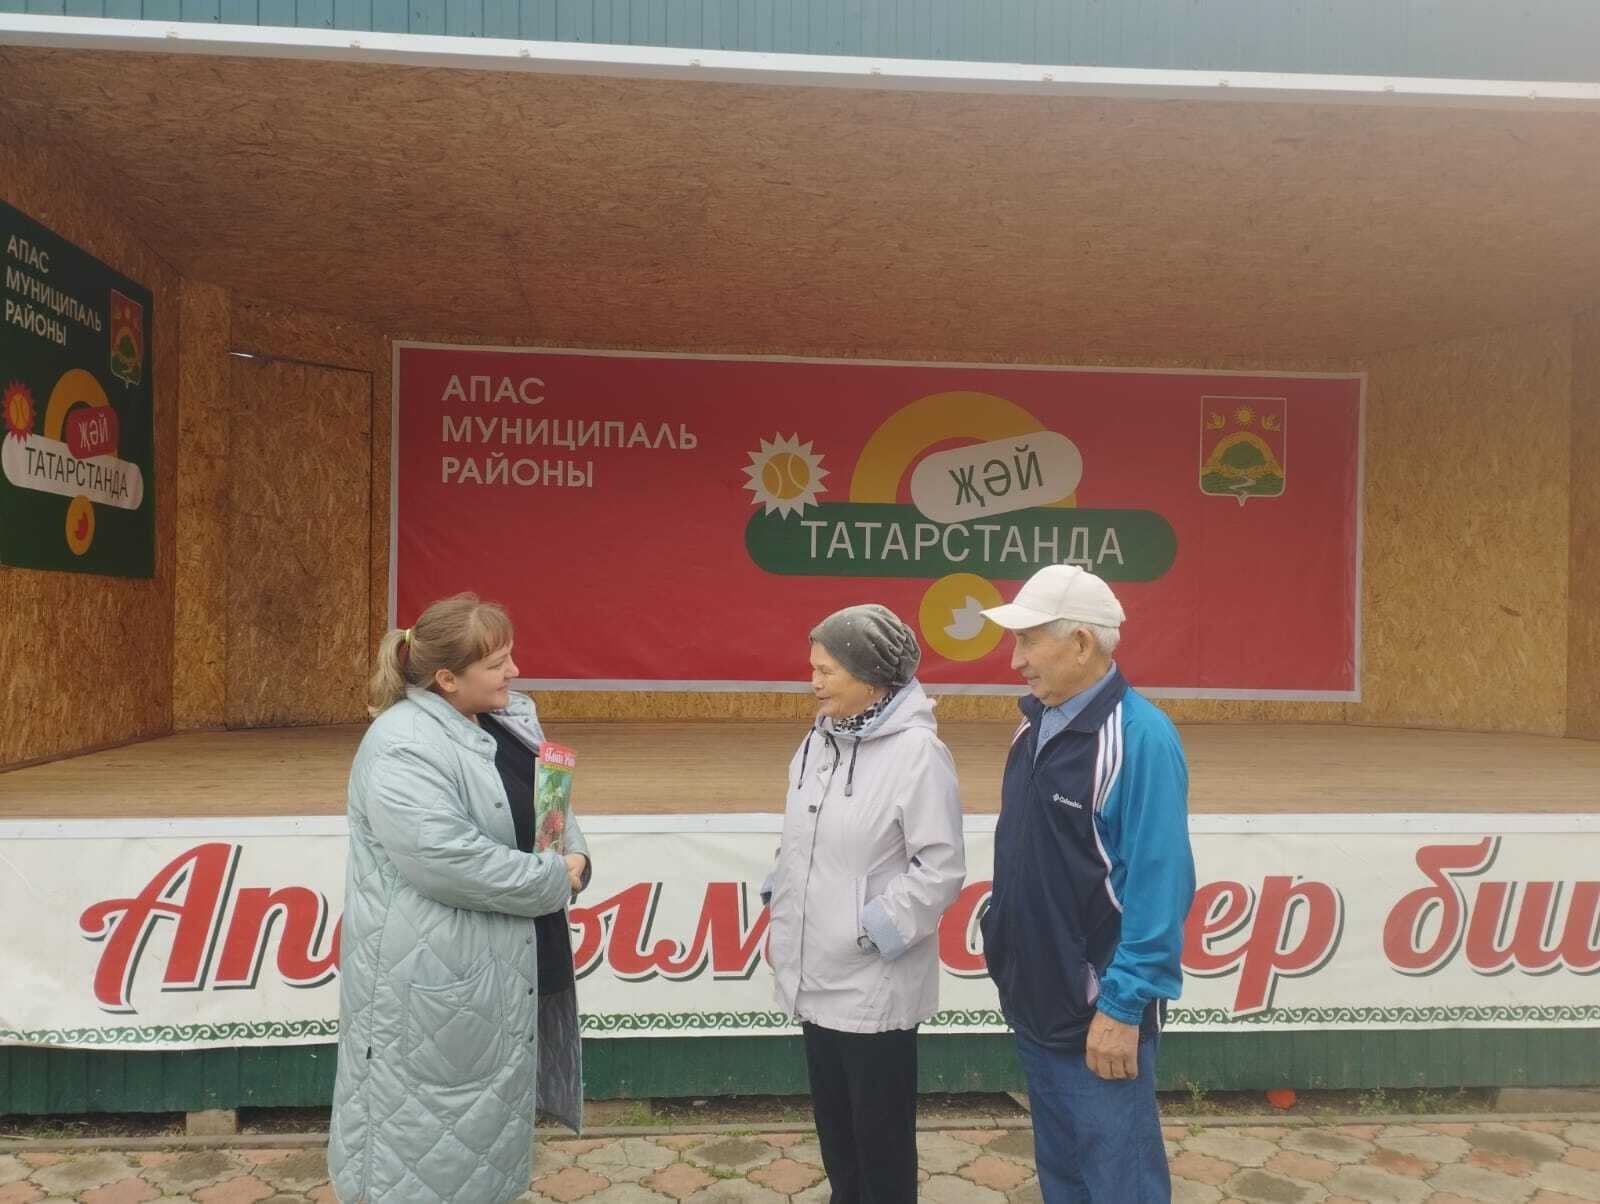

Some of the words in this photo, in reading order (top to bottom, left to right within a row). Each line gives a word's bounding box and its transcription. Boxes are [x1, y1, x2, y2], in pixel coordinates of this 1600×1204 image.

[6, 234, 50, 274] АПАС
[4, 299, 67, 347] РАЙОНЫ
[5, 270, 102, 333] МУНИЦИПАЛЬ
[441, 374, 546, 405] АПАС
[441, 415, 698, 451] МУНИЦИПАЛЬ
[24, 447, 129, 499] ТАТАРСТАНДА
[441, 452, 594, 488] РАЙОНЫ
[799, 520, 1125, 571] ТАТАРСТАНДА
